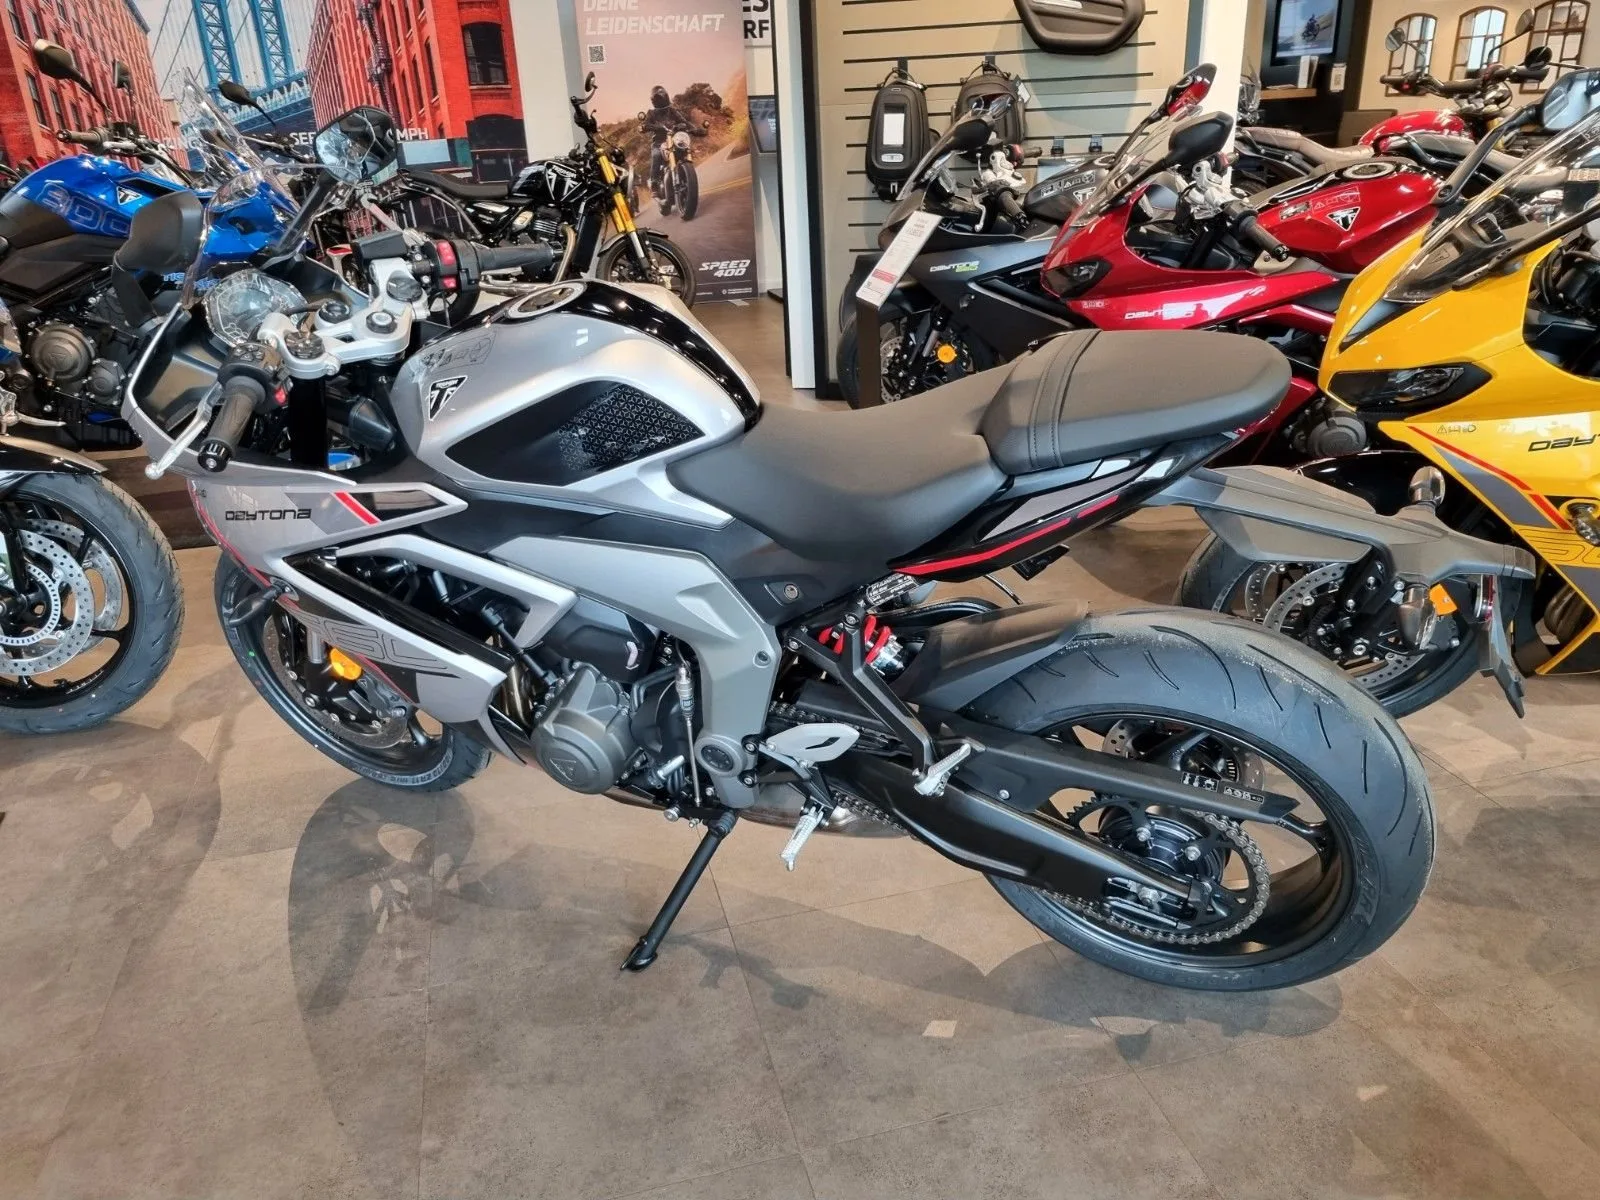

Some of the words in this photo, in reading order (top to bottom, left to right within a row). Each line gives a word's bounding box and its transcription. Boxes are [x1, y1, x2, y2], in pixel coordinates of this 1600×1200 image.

[583, 0, 639, 12] DEINE
[585, 14, 724, 35] LEIDENSCHAFT
[699, 260, 751, 271] SPEED
[714, 268, 747, 278] 400
[1528, 434, 1600, 452] DAY
